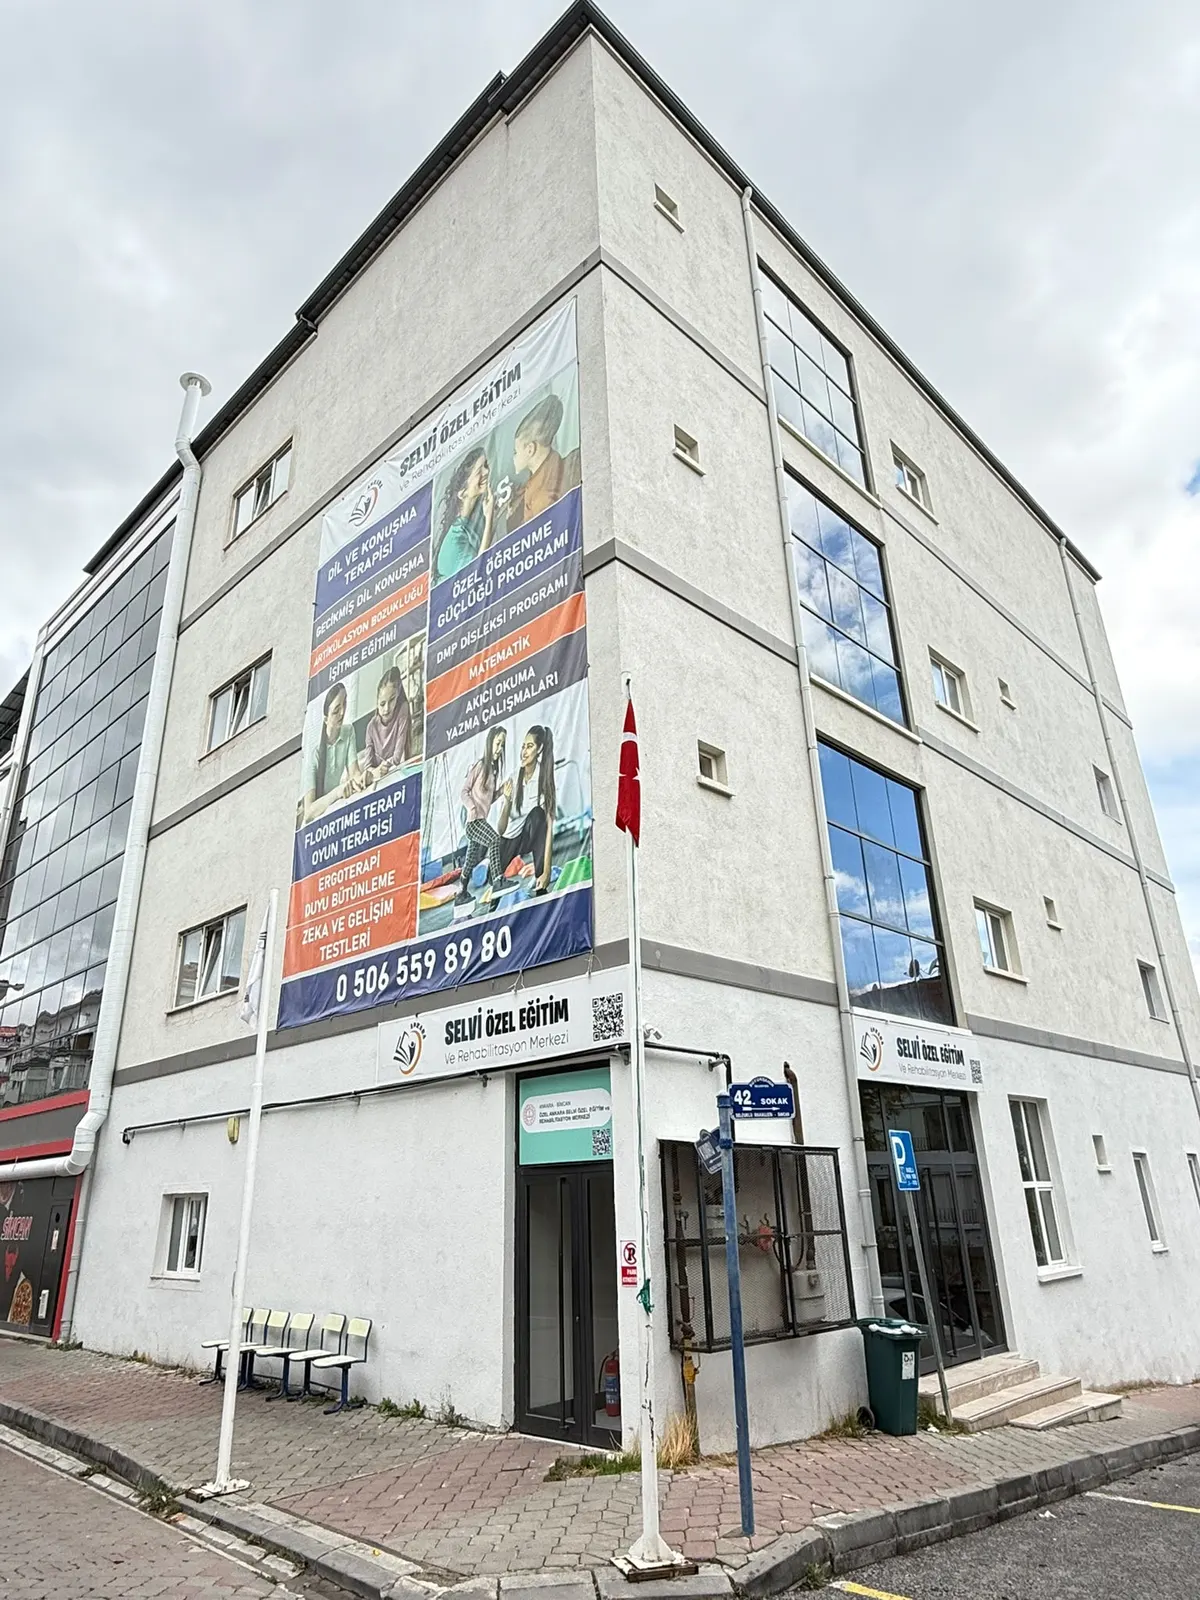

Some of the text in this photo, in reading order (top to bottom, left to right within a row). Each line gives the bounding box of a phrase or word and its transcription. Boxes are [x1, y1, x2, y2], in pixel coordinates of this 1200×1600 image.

[400, 362, 521, 477] SELVİ ÖZEL EĞİTİM
[482, 388, 521, 425] Merkezi
[327, 506, 417, 582] DİL VE KONUŞMA
[344, 537, 394, 585] TERAPİSİ
[452, 520, 552, 598] ÖZEL ÖĞRENME
[316, 553, 424, 638] GECİKMİŞ DİL KONUŞMA
[437, 529, 569, 628] GÜÇLÜĞÜ PROGRAMI
[371, 584, 424, 627] BOZUKLUĞU
[436, 573, 568, 664] DMP DİSLEKSİ PROGRAMI
[329, 625, 397, 681] İŞİTME EĞİTİMİ
[469, 635, 531, 680] MATEMATİK
[446, 671, 559, 742] YAZMA ÇALIŞMALARI
[465, 666, 536, 714] AKICI OKUMA
[304, 785, 406, 849] FLOORTIME TERAPİ
[311, 814, 393, 866] OYUN TERAPİSİ
[304, 870, 396, 918] DUYU BÜTÜNLEME
[318, 851, 381, 892] ERGOTERAPİ
[302, 898, 394, 945] ZEKA VE GELİŞİM
[320, 927, 371, 961] TESTLERİ
[336, 925, 512, 1003] 0 506 559 89 80
[445, 995, 569, 1045] SELVİ ÖZEL EĞİTİM
[445, 1030, 569, 1065] Ve Rehabilitasyon Merkezi
[896, 1035, 921, 1060] SELVİ
[922, 1040, 940, 1062] ÖZEL
[940, 1043, 965, 1067] EĞİTİM
[734, 1090, 756, 1105] 42.
[891, 1136, 906, 1183] P
